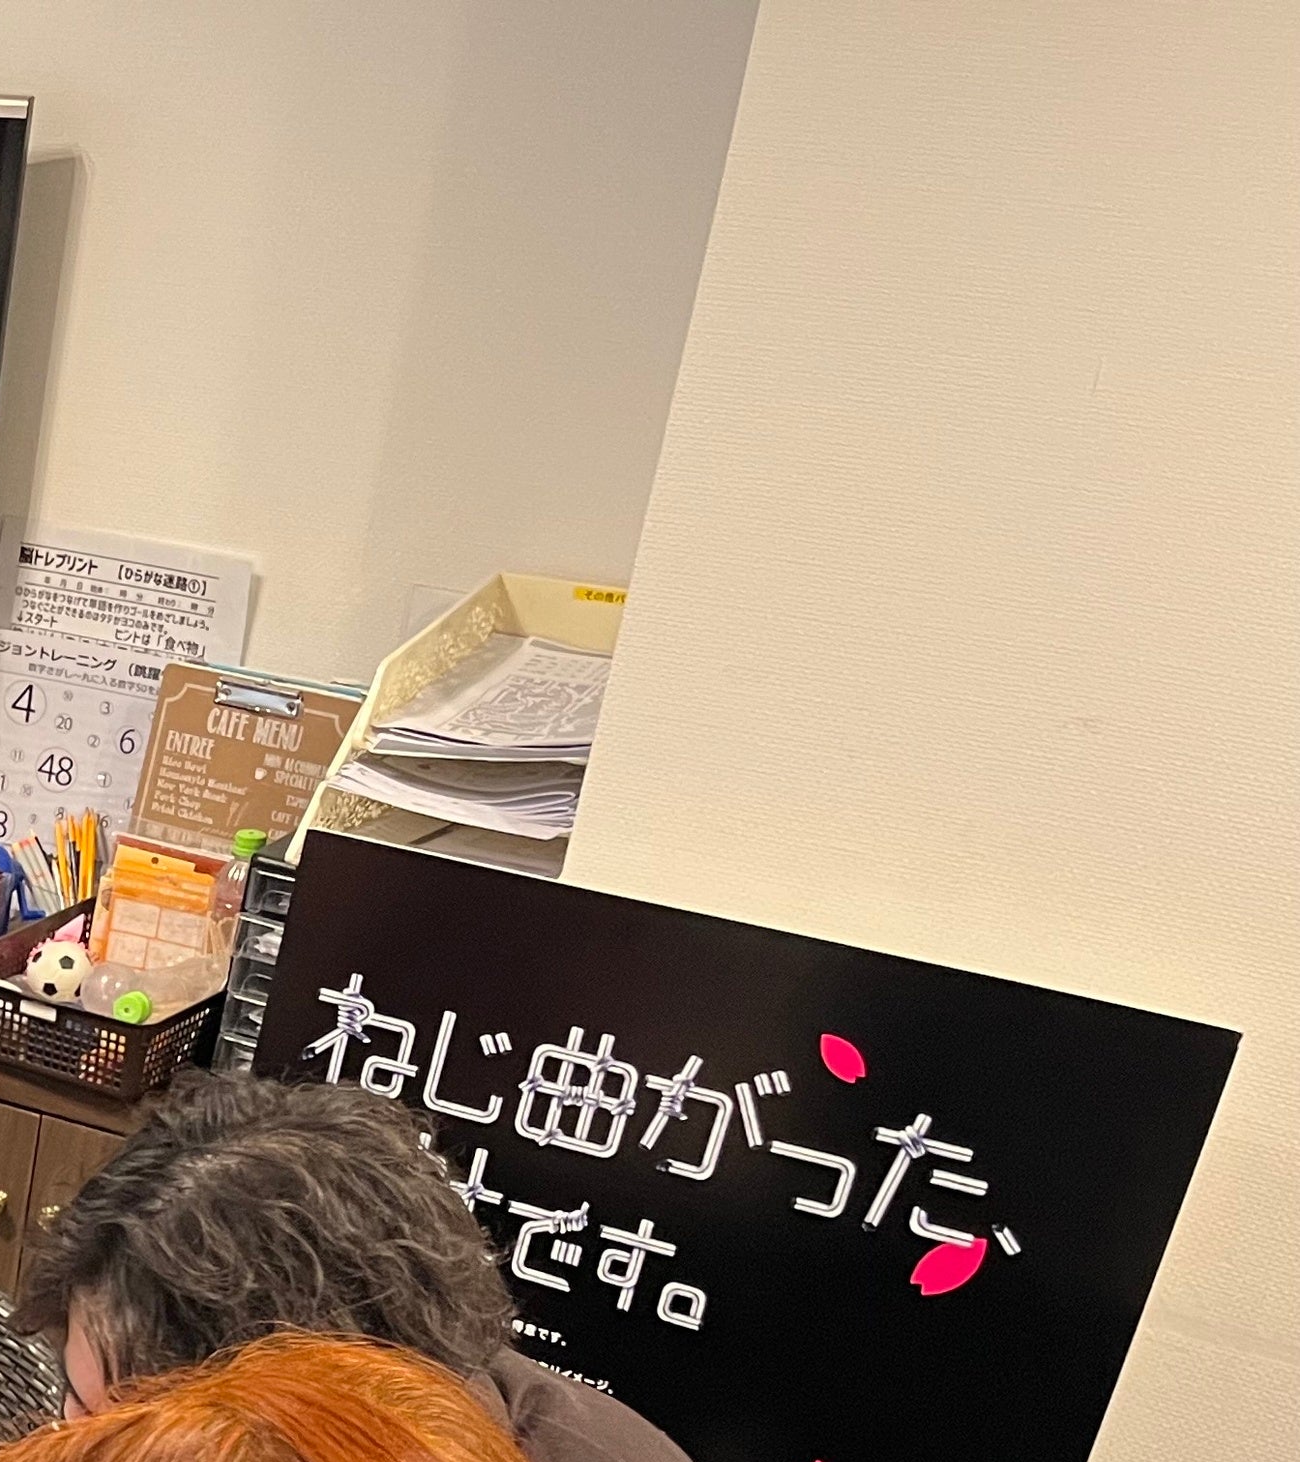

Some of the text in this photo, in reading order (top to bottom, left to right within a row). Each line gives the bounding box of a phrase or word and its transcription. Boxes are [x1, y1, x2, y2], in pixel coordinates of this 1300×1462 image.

[11, 684, 36, 723] 4
[102, 701, 111, 715] 3
[55, 715, 73, 731] 20
[207, 707, 305, 752] CAFE MENU
[119, 728, 136, 755] 6
[165, 729, 216, 760] ENTREE
[37, 753, 74, 787] 48
[302, 973, 1022, 1257] ねじ曲がった、
